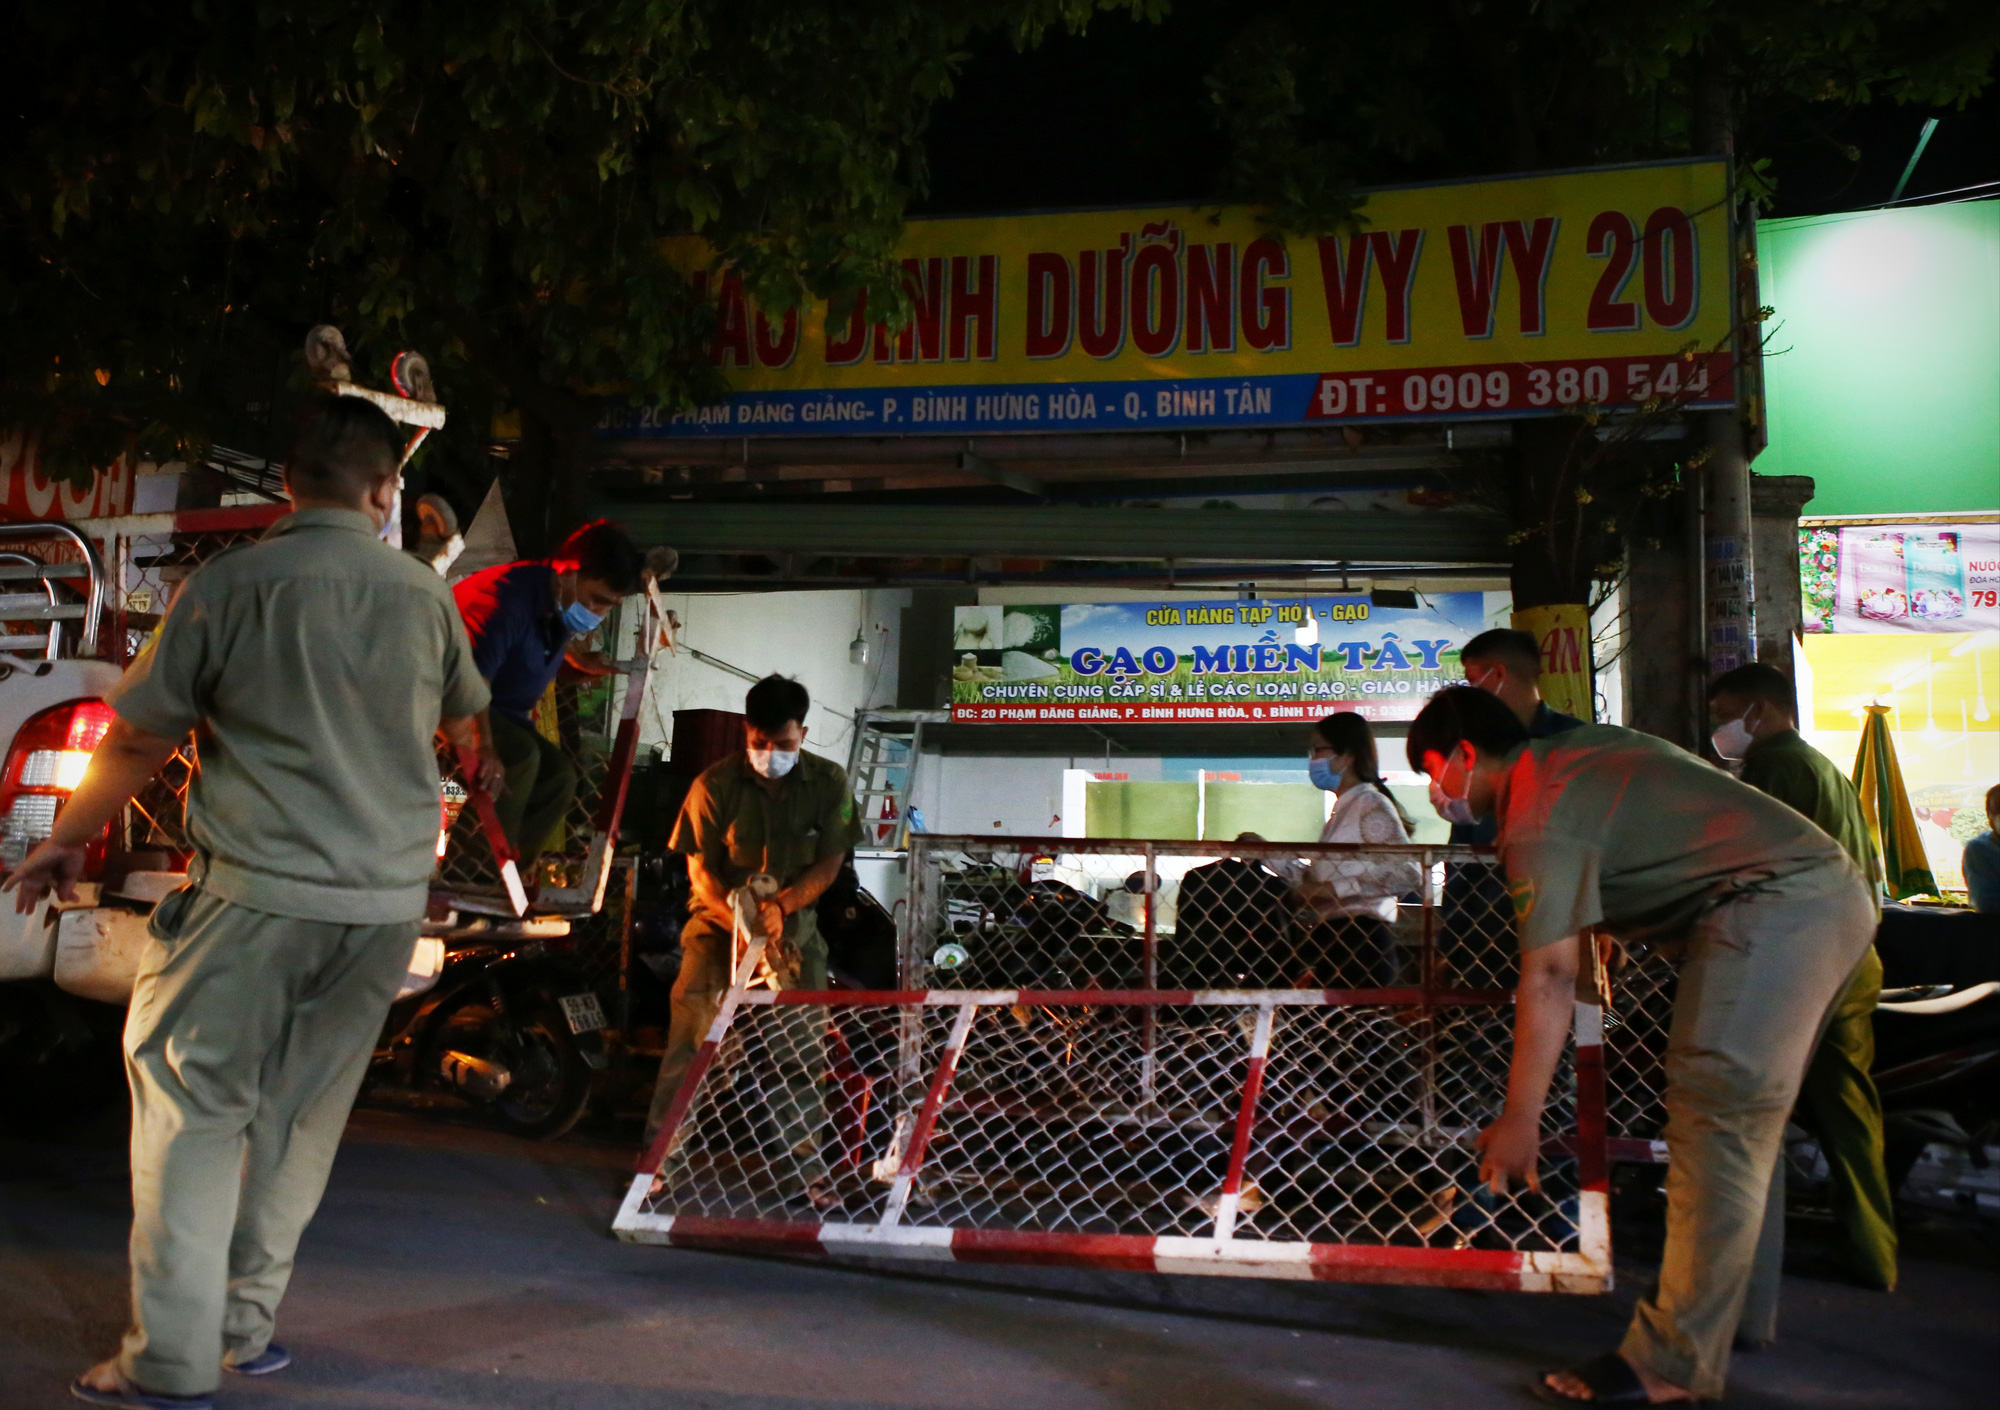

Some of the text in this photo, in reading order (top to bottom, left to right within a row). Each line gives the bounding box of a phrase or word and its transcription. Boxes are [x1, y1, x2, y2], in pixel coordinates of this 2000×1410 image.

[1026, 219, 1291, 360] DƯỠNG
[1317, 228, 1425, 346] VY
[1447, 217, 1560, 339] VY
[1586, 206, 1698, 331] 20
[738, 400, 795, 424] ĐĂNG
[883, 397, 904, 423] P.
[912, 390, 967, 423] BÌNH
[976, 392, 1040, 421] HƯNG
[1048, 387, 1097, 420] HÒA
[1124, 392, 1147, 421] Q.
[1157, 384, 1216, 418] BÌNH
[1224, 382, 1271, 415] TÂN
[1319, 377, 1386, 415] ĐT:
[1403, 370, 1510, 412] 0909
[1527, 365, 1609, 406] 380
[1146, 604, 1182, 625] CỬA
[1186, 604, 1234, 625] HÀNG
[1239, 607, 1273, 627] TẠP
[1278, 602, 1313, 624] HÓ
[1332, 603, 1370, 625] GẠO
[1070, 629, 1452, 684] GẠO MIỀN TÂY
[982, 682, 1049, 699] CHUYÊN
[1053, 684, 1103, 698] CUNG
[1108, 680, 1145, 697] CẤP
[1149, 680, 1165, 697] SỈ
[1169, 685, 1183, 697] &
[1188, 679, 1205, 697] LẺ
[1209, 680, 1251, 697] CÁC
[1255, 682, 1298, 699] LOẠI
[1302, 682, 1346, 699] GẠO
[1361, 681, 1411, 694] GIAO
[957, 709, 978, 719] ĐC:
[981, 709, 997, 719] 20
[1000, 708, 1037, 721] PHẠM
[1040, 706, 1075, 719] ĐĂNG
[1078, 706, 1122, 719] GIẢNG,
[1125, 708, 1138, 718] P.
[1141, 705, 1174, 718] BÌNH
[1177, 706, 1214, 718] HƯNG
[1218, 704, 1249, 719] HÒA,
[1253, 707, 1266, 718] Q.
[1270, 705, 1303, 717] BÌNH
[1307, 703, 1335, 717] TÂN
